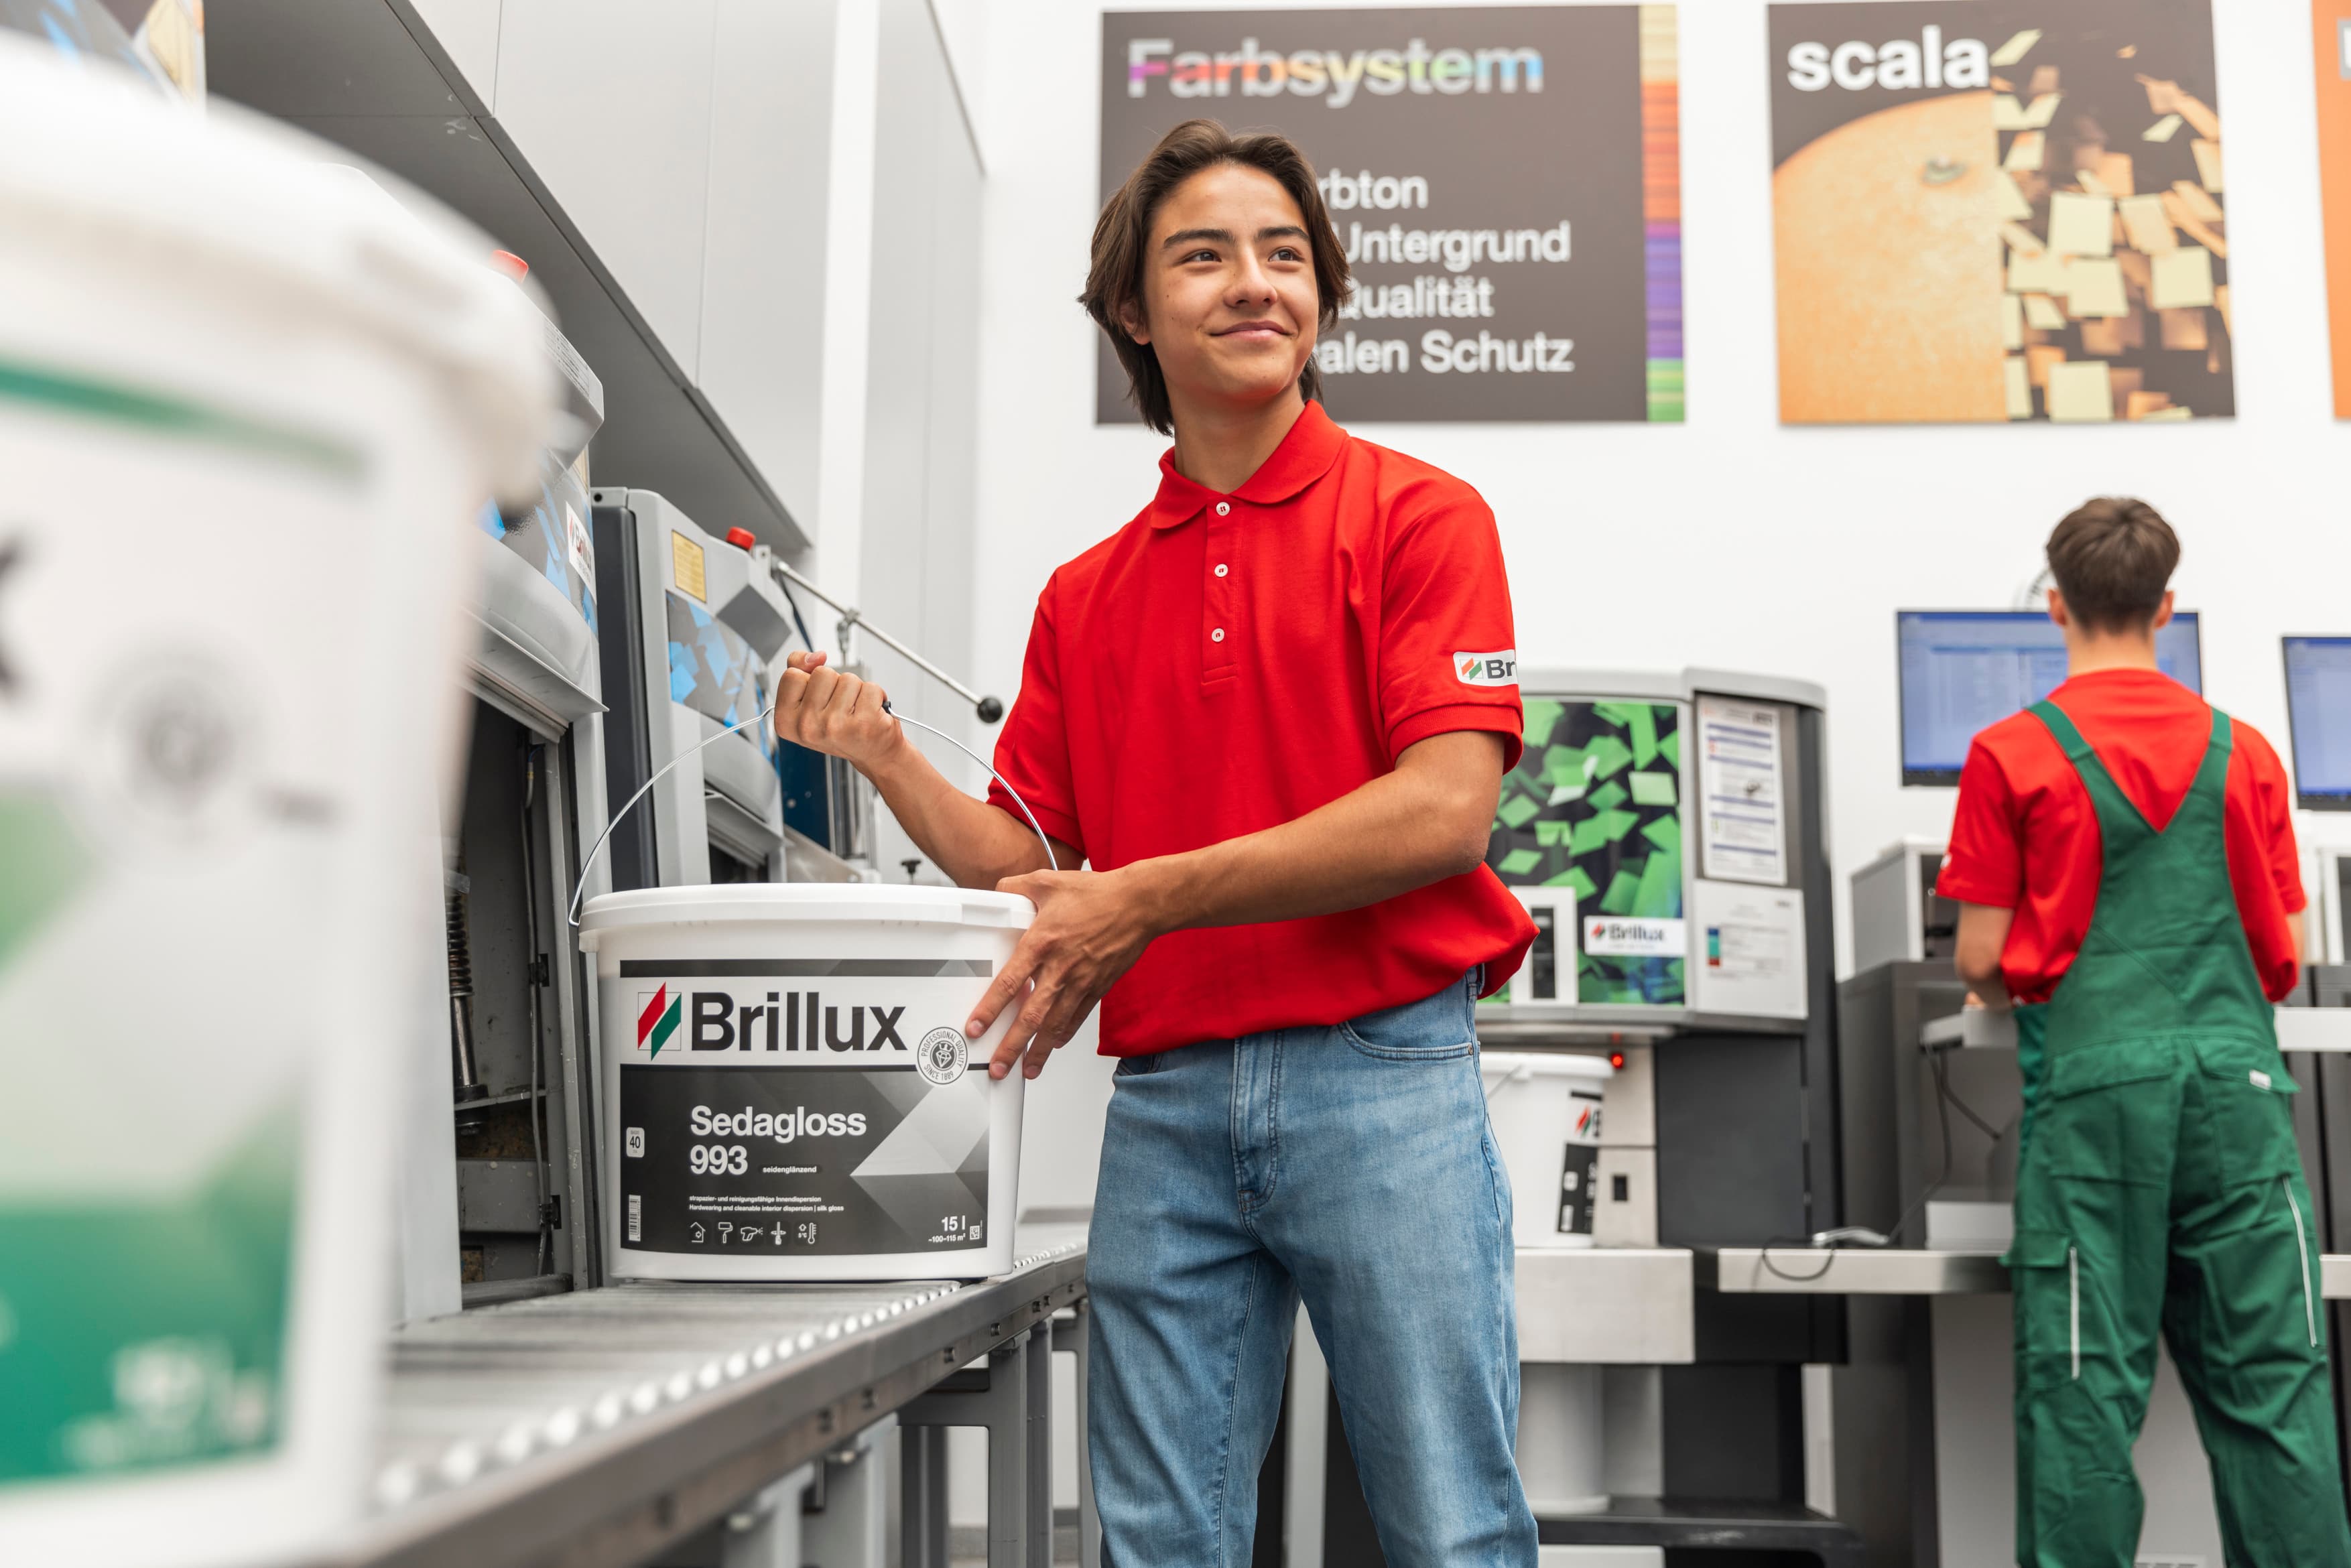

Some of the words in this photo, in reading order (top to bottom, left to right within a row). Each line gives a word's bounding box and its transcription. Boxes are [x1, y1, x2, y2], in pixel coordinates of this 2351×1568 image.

[1128, 38, 1543, 109] Farbsystem
[1787, 24, 1989, 91] scala
[1314, 331, 1410, 374] alen
[1420, 329, 1575, 373] Schutz
[692, 992, 908, 1052] Brillux
[921, 1031, 956, 1057] PROFESSIONAL
[955, 1040, 965, 1067] QUALITY
[924, 1063, 940, 1080] SINCE
[941, 1071, 954, 1081] 1889
[629, 1136, 641, 1149] 40
[690, 1106, 867, 1143] Sedagloss
[690, 1145, 749, 1175] 993
[763, 1166, 817, 1174] seidenglänzend
[942, 1216, 958, 1231] 15
